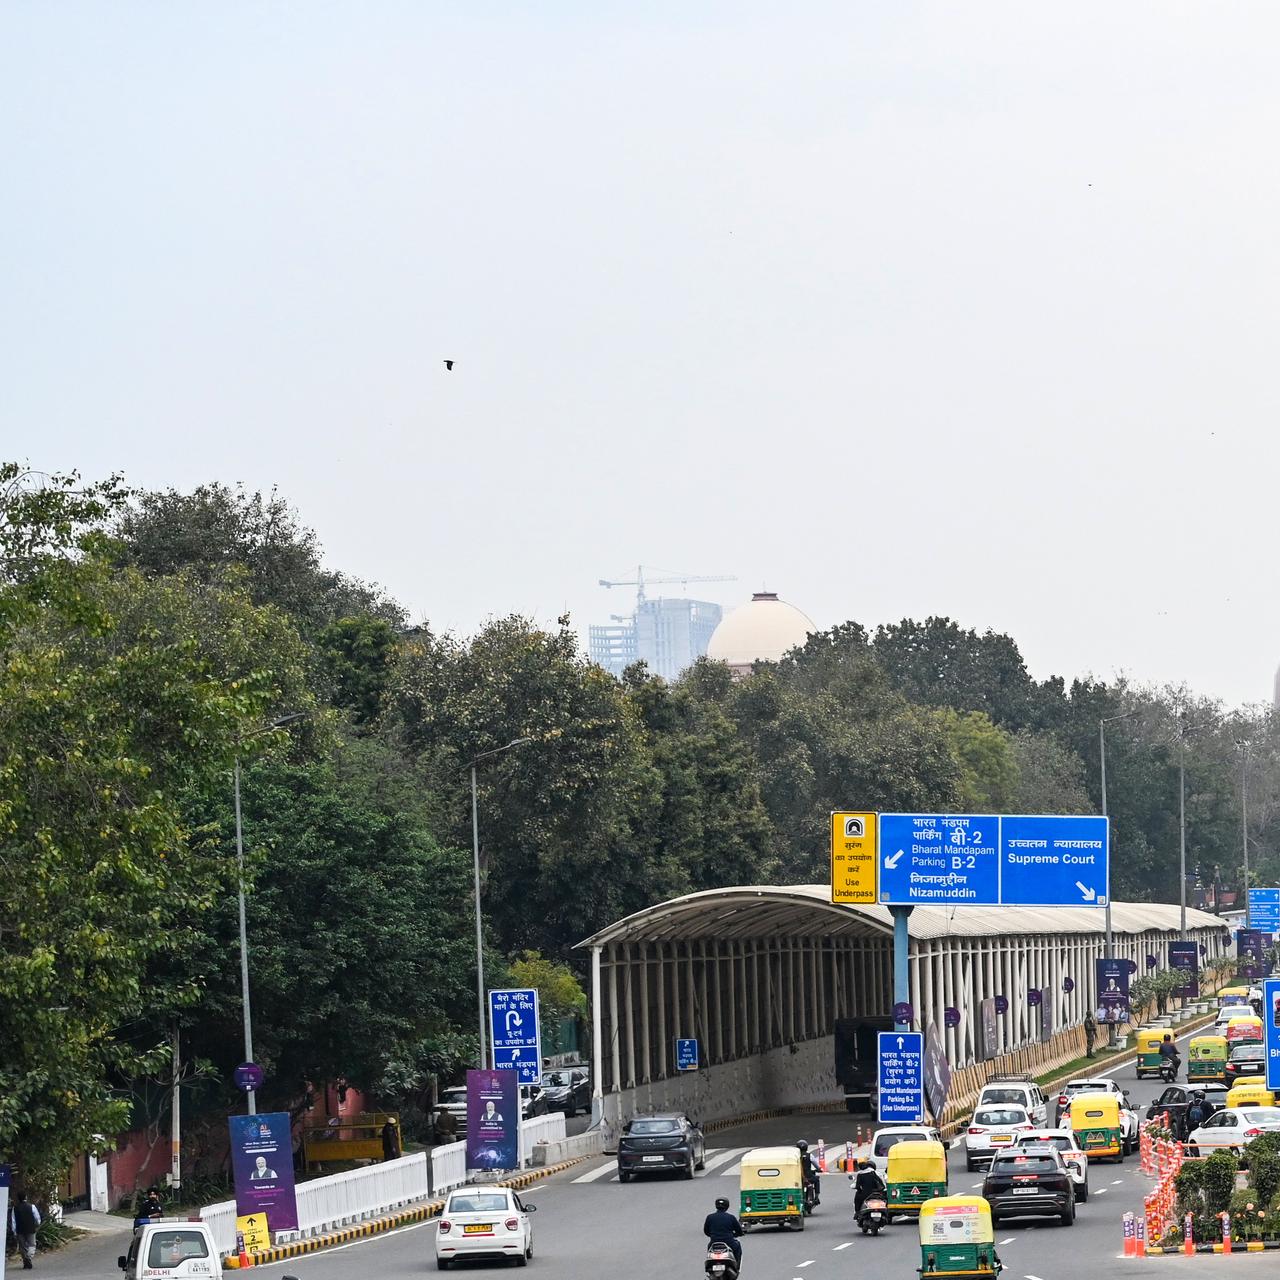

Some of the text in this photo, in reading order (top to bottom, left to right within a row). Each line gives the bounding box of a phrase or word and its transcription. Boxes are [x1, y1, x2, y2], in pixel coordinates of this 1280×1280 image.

[912, 815, 970, 828] भारत मंडपम
[950, 827, 982, 846] बी-2
[1007, 839, 1103, 849] उच्चतम न्यायालय
[911, 845, 995, 857] Bharat Mandapam
[911, 856, 976, 869] Parking B-2
[1008, 853, 1095, 865] Supreme Court
[845, 878, 860, 886] Use
[835, 889, 874, 898] Underpass
[909, 888, 977, 898] Nizamuddin
[896, 1087, 921, 1095] Mandapam
[887, 1095, 906, 1103] Parking
[881, 1104, 920, 1113] (Use Underpass)
[250, 1234, 257, 1242] 2
